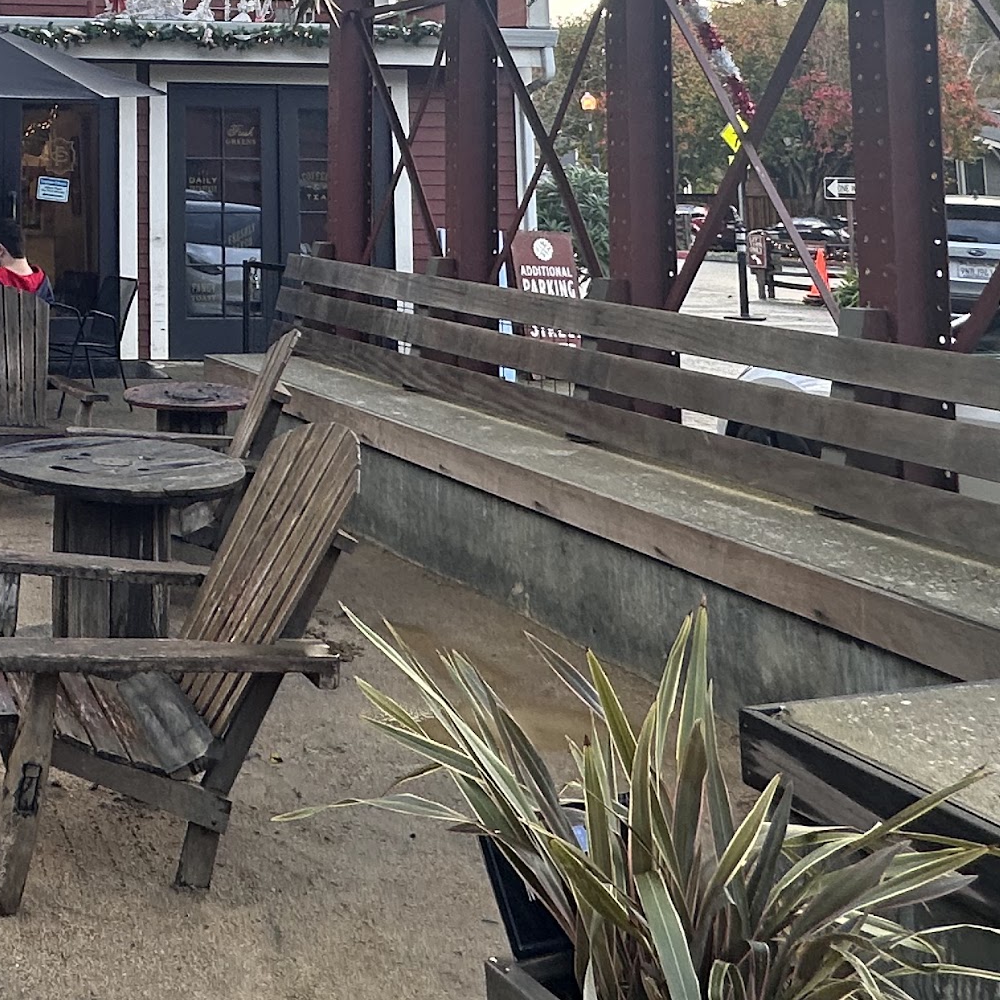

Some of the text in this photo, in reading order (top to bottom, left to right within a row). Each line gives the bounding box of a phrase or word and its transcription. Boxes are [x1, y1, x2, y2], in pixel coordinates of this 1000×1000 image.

[188, 177, 218, 185] DAILY
[520, 265, 573, 277] ADDITIONAL
[522, 278, 576, 299] PARKING
